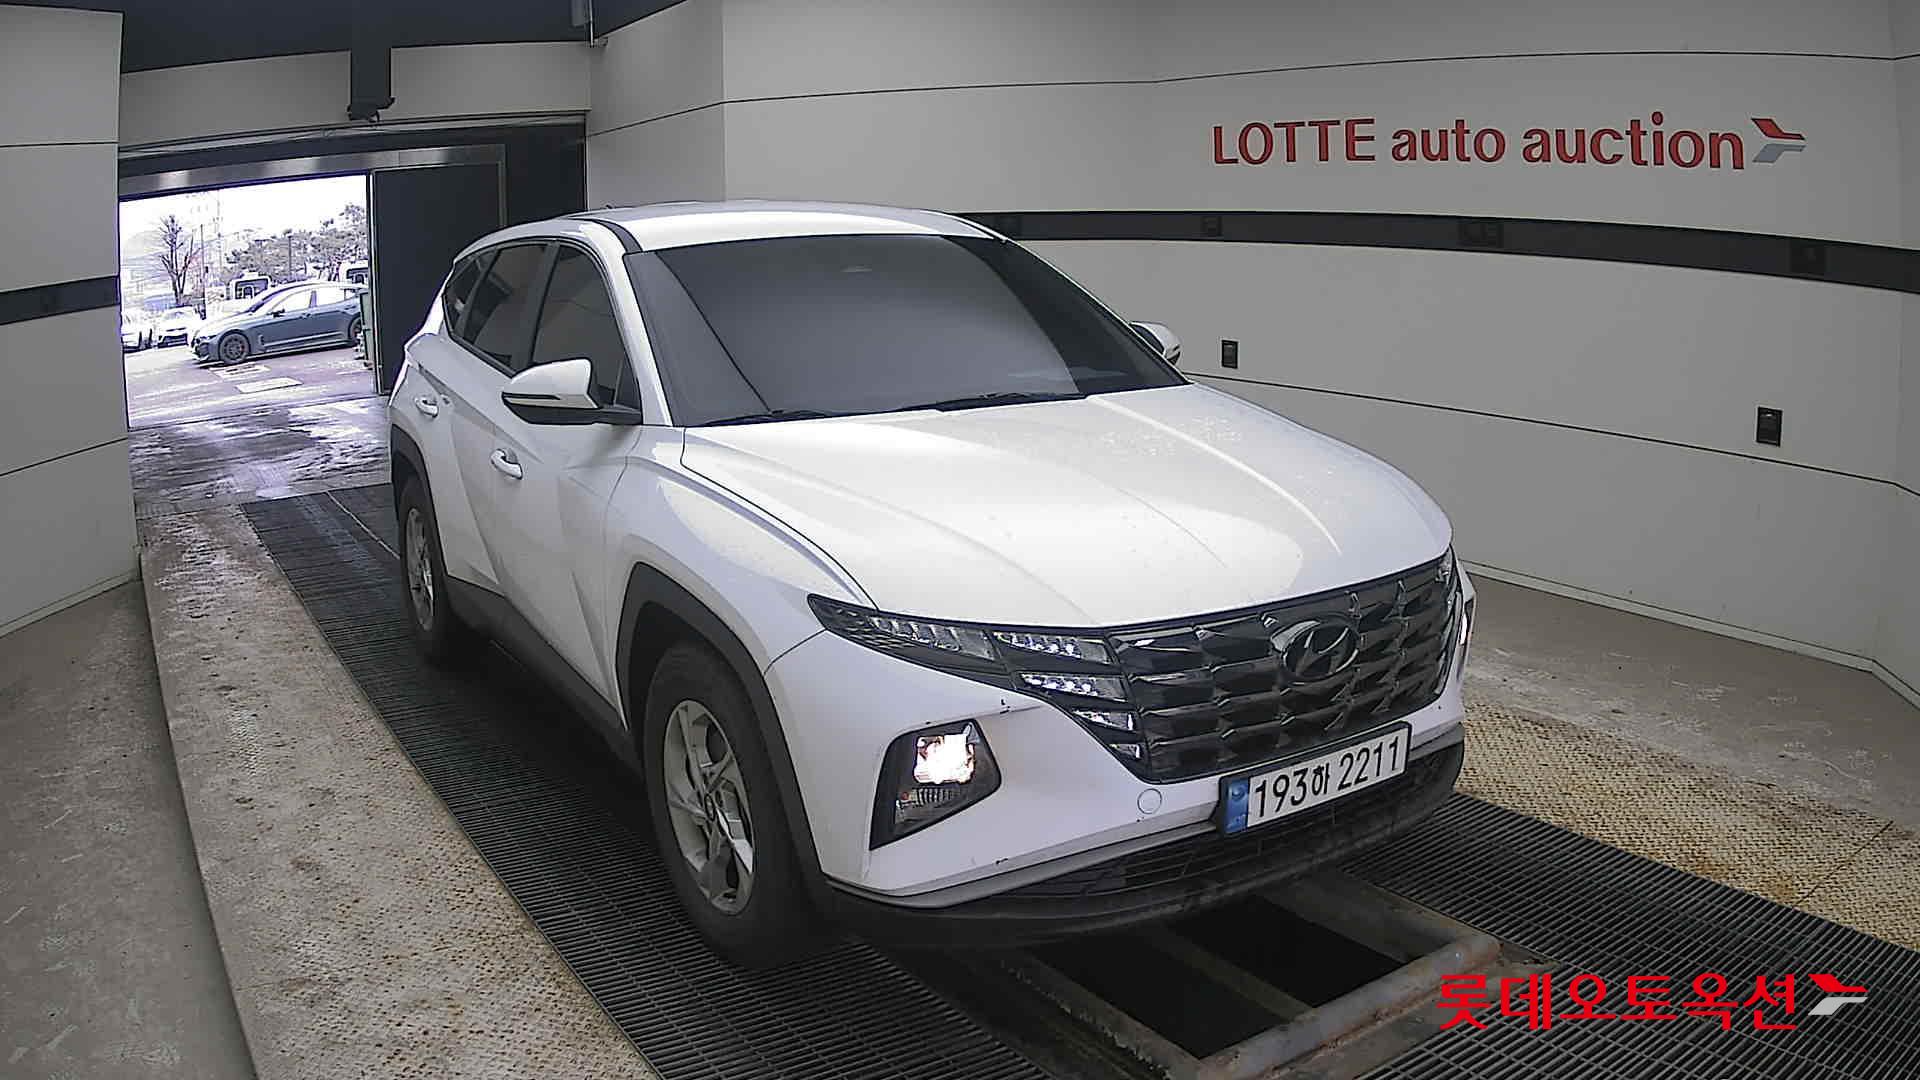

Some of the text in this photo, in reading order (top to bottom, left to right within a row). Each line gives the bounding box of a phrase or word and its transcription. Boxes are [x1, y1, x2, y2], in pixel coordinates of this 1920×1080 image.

[1213, 111, 1744, 170] LOTTE auto auction
[1255, 736, 1399, 817] 193하 2211
